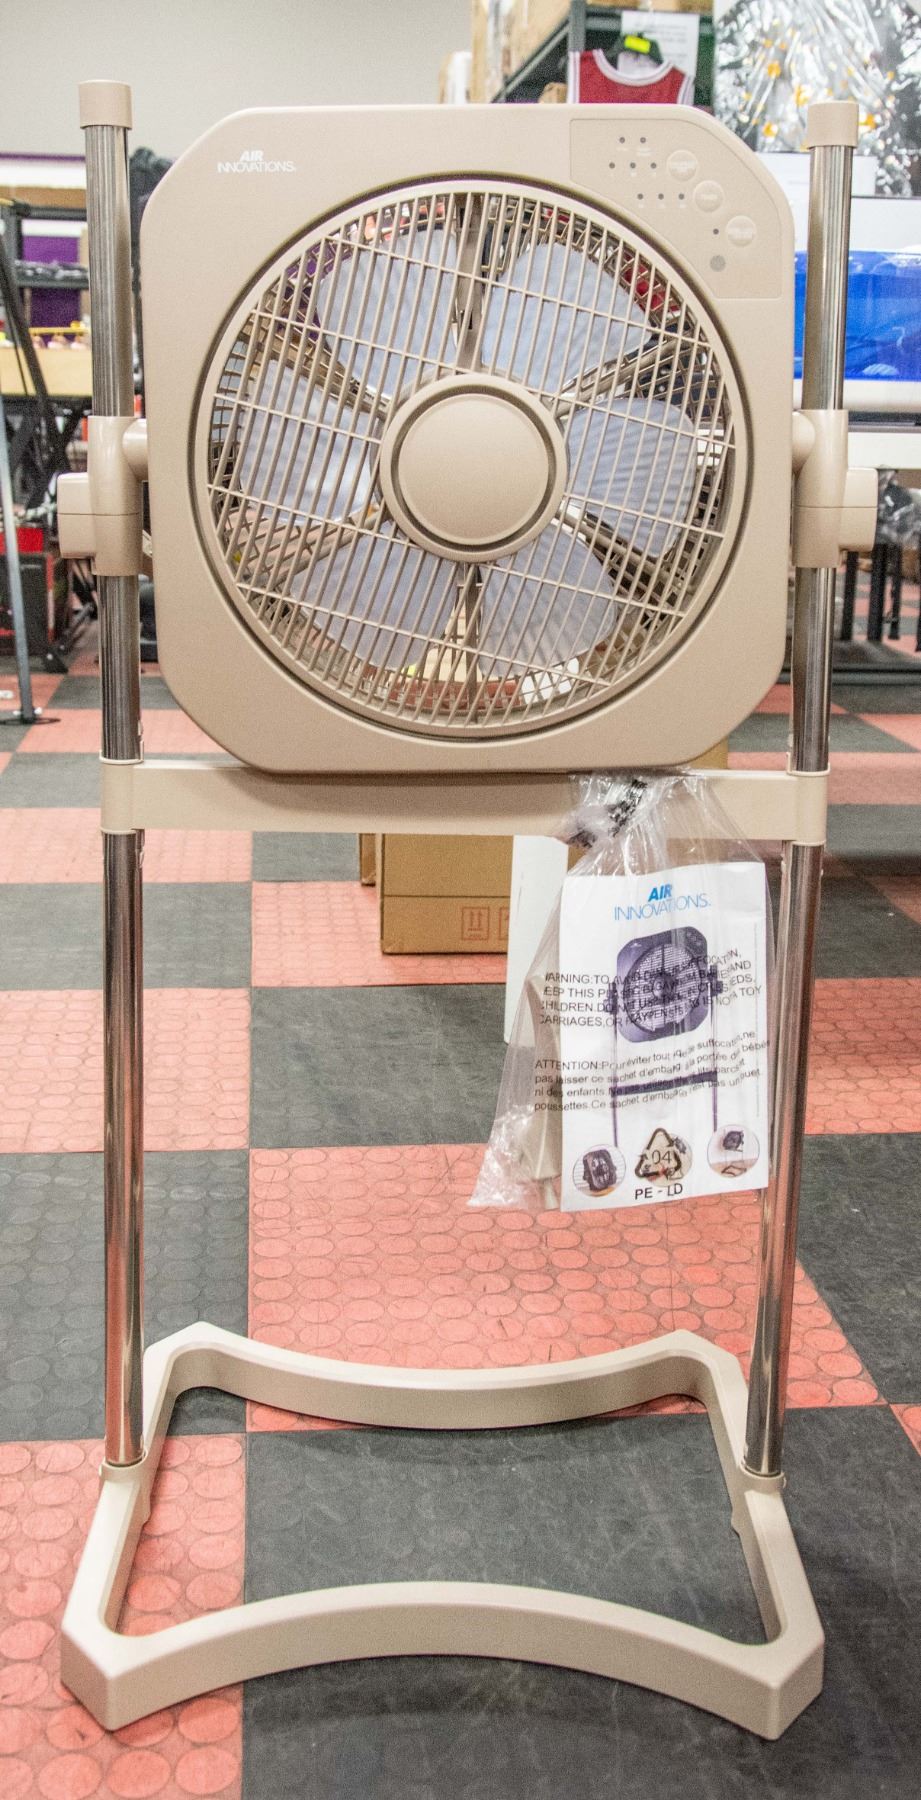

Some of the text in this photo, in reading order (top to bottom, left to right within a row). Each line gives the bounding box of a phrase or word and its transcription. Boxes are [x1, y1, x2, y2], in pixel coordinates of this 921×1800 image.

[240, 150, 264, 161] AIR
[648, 884, 672, 902] AIR
[544, 986, 565, 997] EEP
[568, 987, 595, 998] THIS
[728, 960, 752, 972] AND
[740, 985, 762, 997] TOY
[626, 1055, 652, 1067] éviter
[653, 1052, 671, 1062] tout
[534, 1075, 554, 1085] pas
[555, 1075, 588, 1085] laisser
[591, 1075, 605, 1083] ce
[607, 1071, 637, 1083] sachet
[534, 1086, 544, 1097] ni
[652, 1149, 672, 1165] 04
